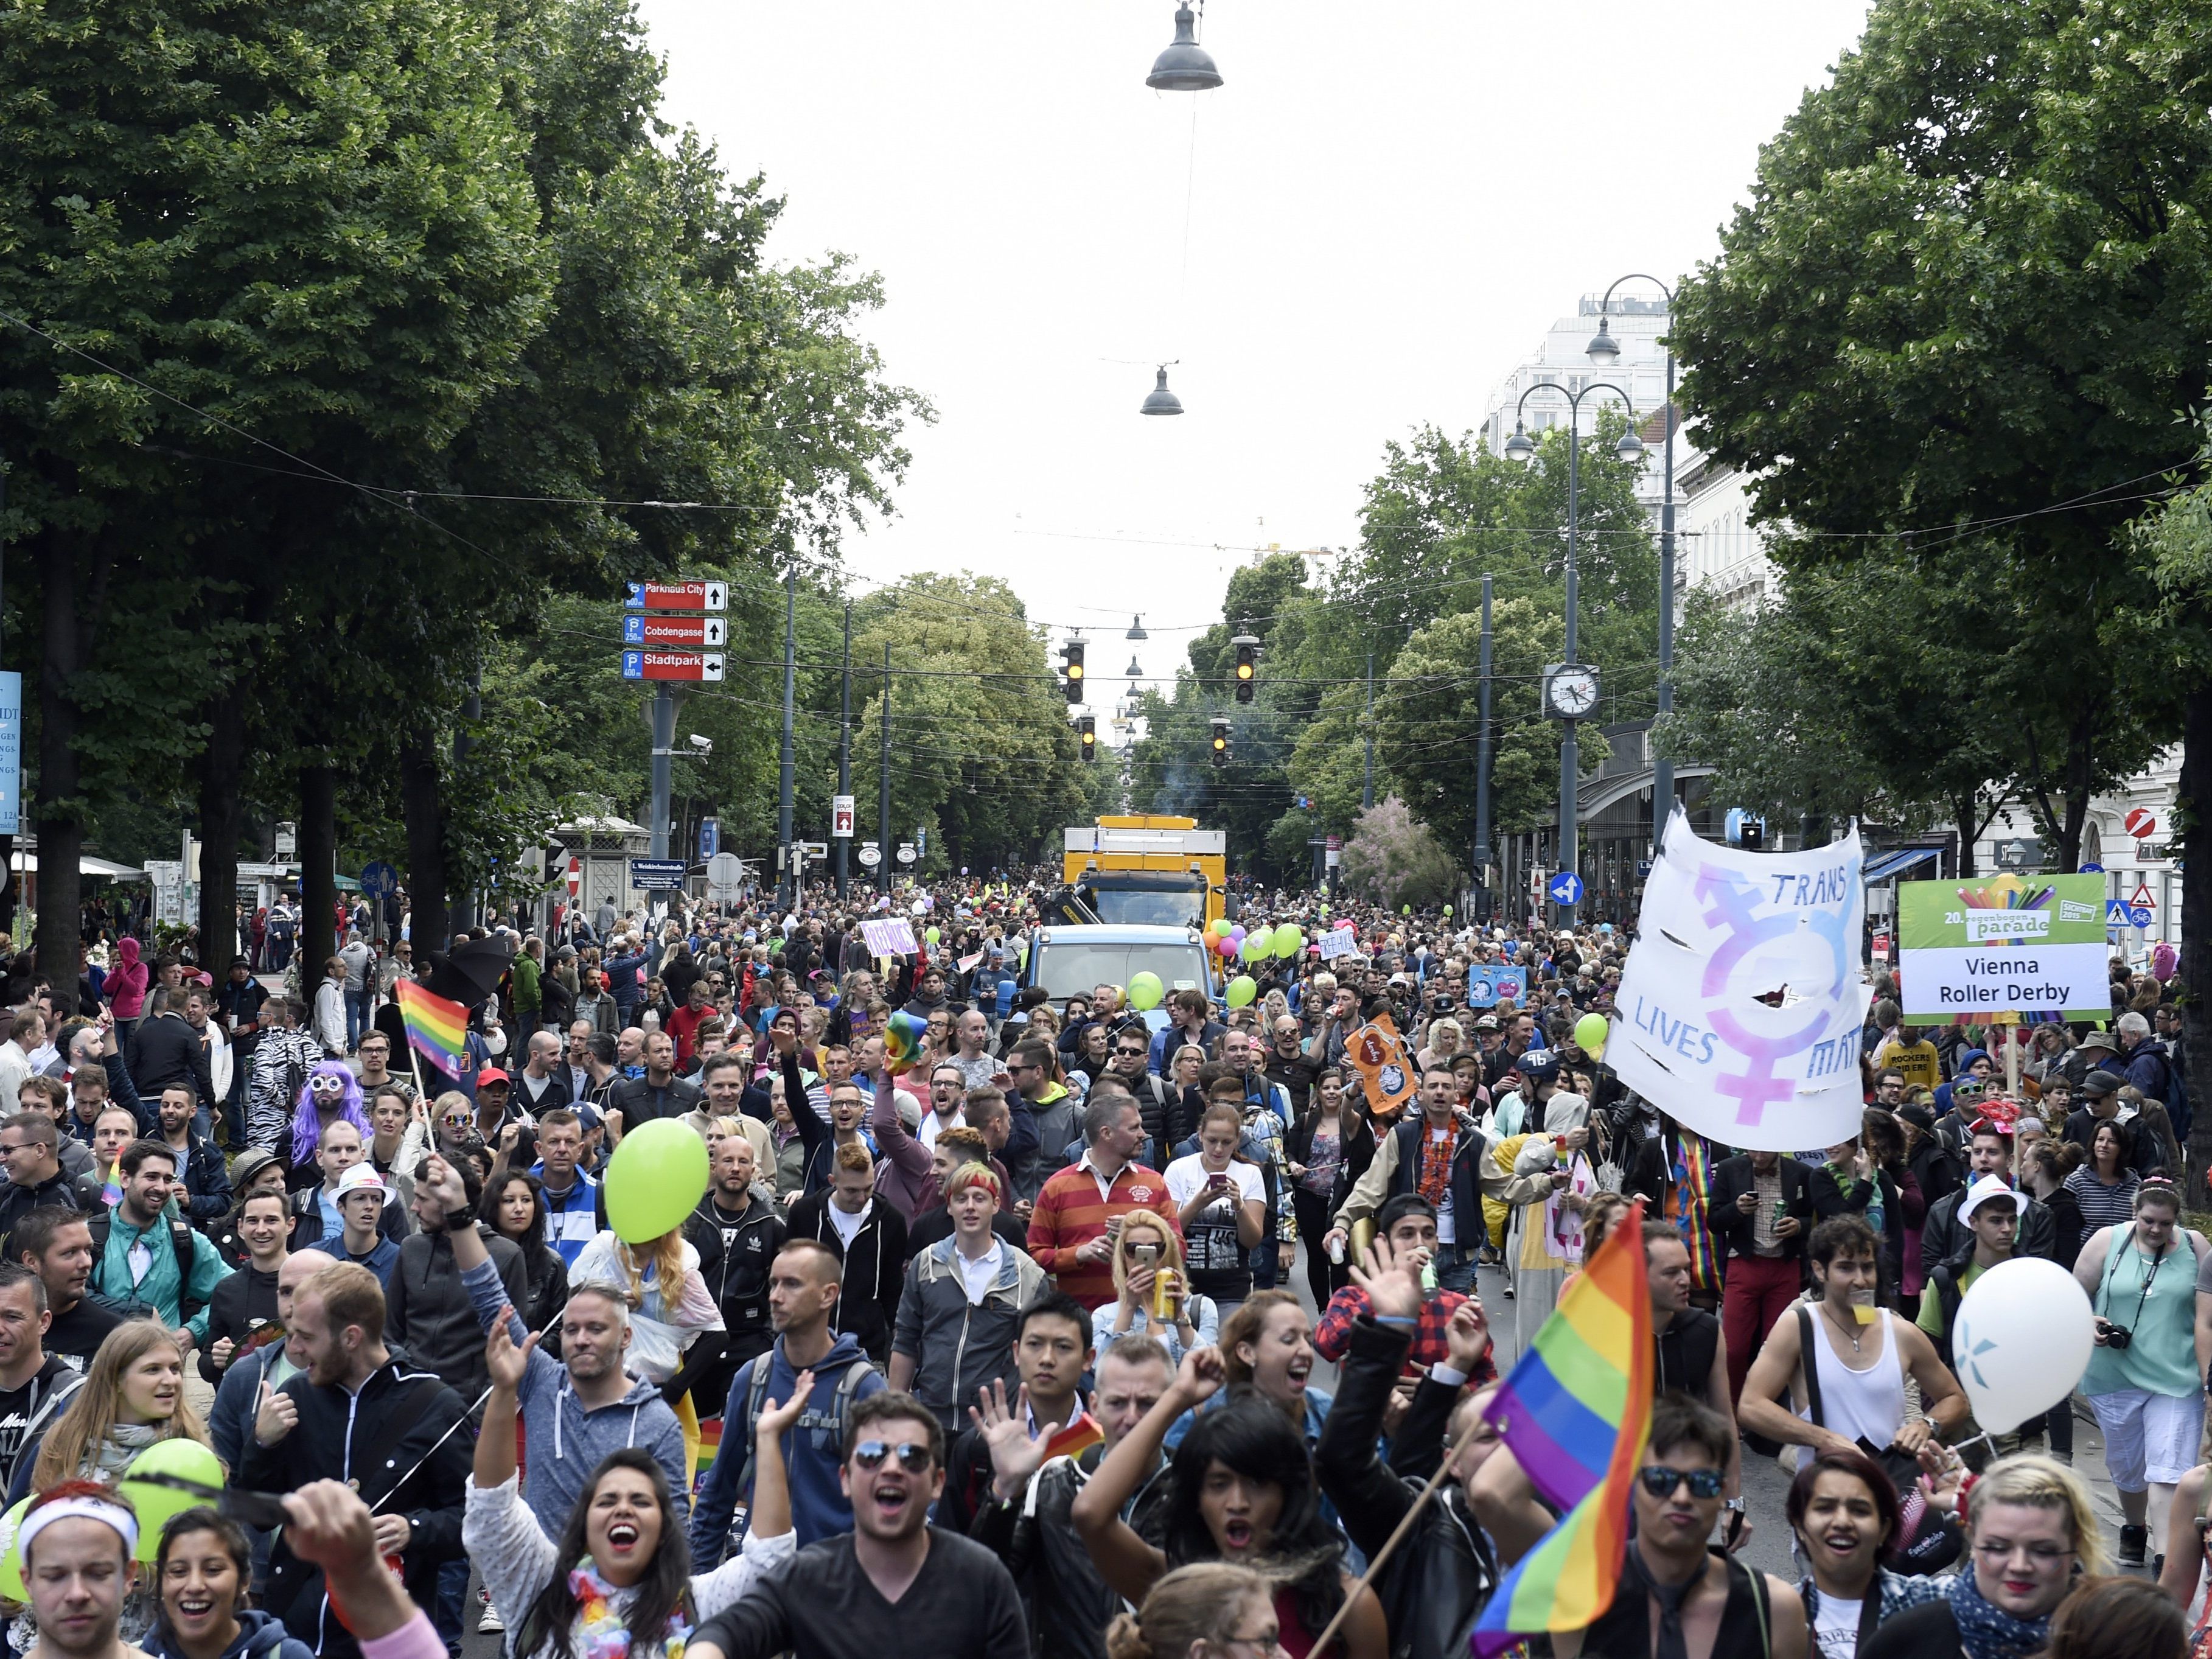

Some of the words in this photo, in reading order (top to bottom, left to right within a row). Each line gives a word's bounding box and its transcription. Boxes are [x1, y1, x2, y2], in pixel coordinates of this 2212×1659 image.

[645, 584, 685, 593] Parkhaus
[687, 585, 704, 595] City
[645, 626, 703, 637] Cobdengasse
[644, 654, 701, 666] Stadtpark
[1771, 865, 1846, 906] TRANS
[1945, 912, 1964, 924] 20.
[1966, 914, 2028, 923] regenbogen
[1978, 918, 2049, 938] parade
[1965, 957, 2039, 975] Vienna
[1500, 987, 1515, 996] Derby
[1940, 984, 2000, 1002] Roller
[2007, 982, 2070, 1005] Derby
[1635, 995, 1718, 1064] LIVES
[1366, 1039, 1380, 1062] derby
[1891, 1054, 1930, 1064] ROCKERS
[1794, 1151, 1824, 1161] DERBY
